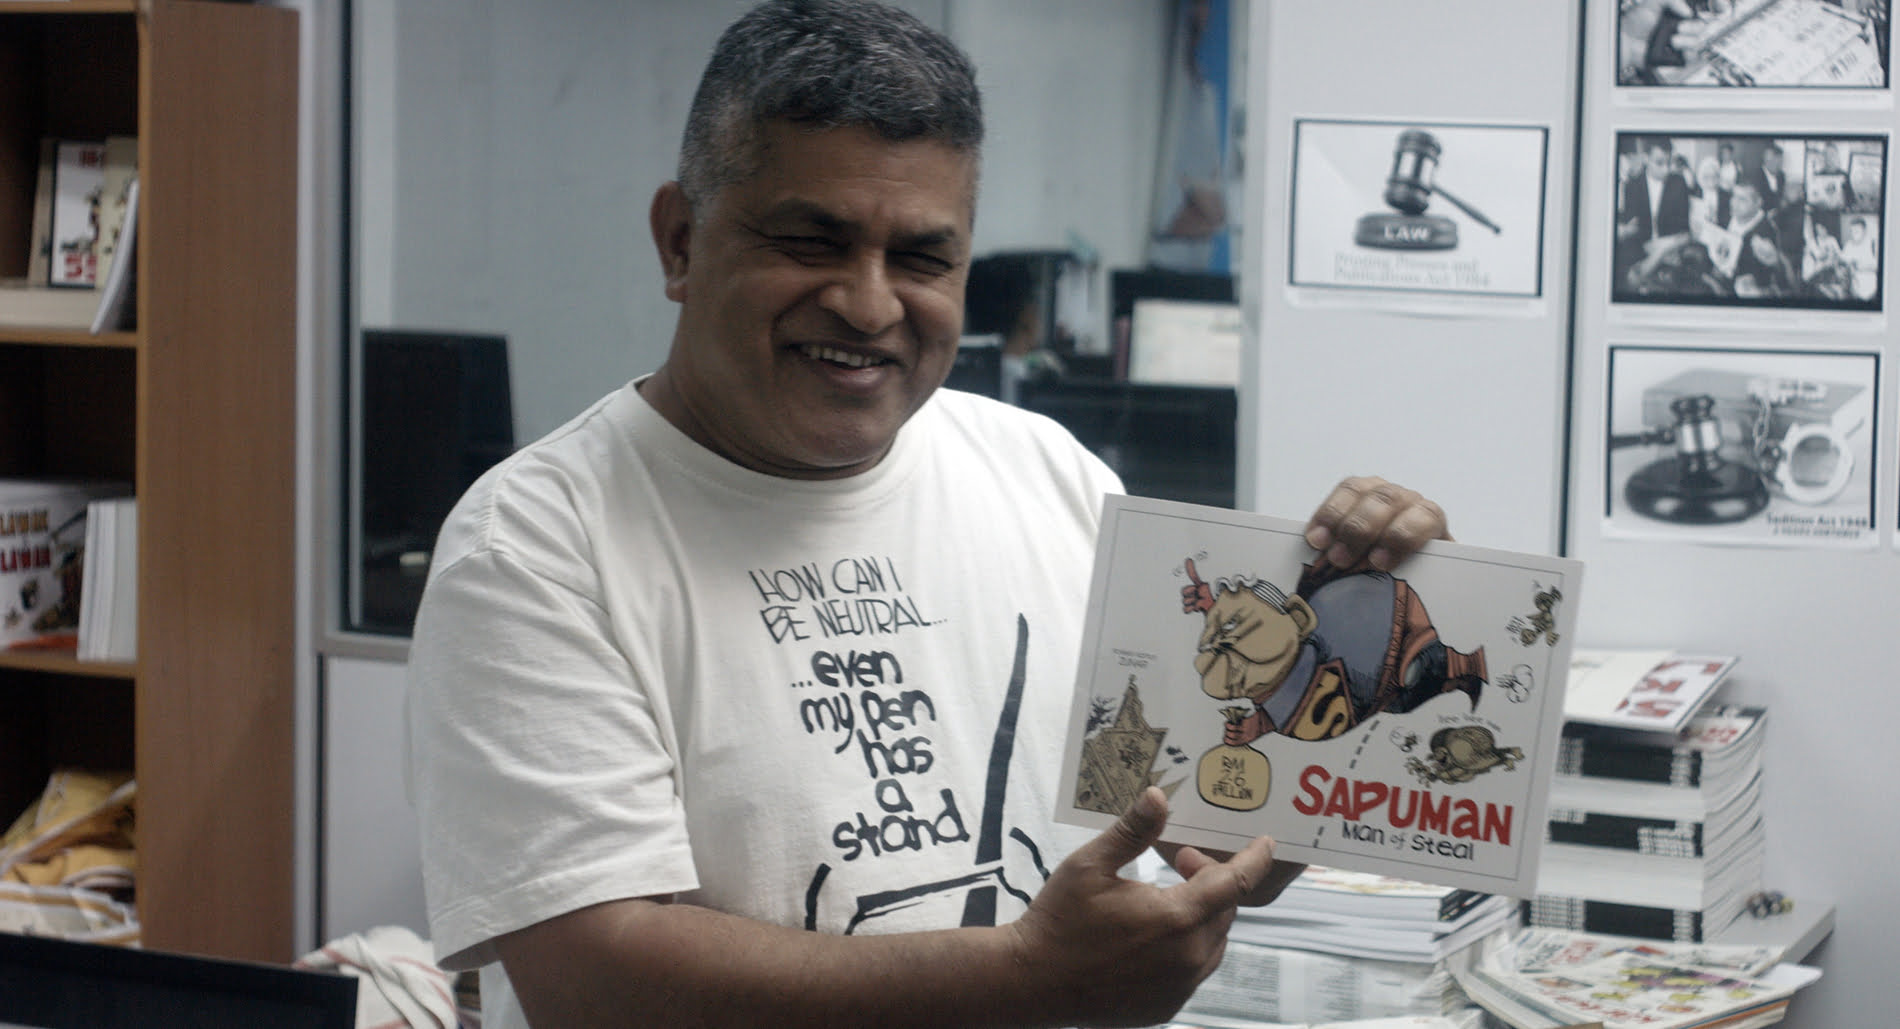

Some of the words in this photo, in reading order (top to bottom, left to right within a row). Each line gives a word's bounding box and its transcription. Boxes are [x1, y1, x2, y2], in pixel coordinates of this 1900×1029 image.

[1383, 223, 1431, 242] LAW
[748, 562, 826, 603] HOW
[832, 556, 886, 594] CAN
[886, 556, 903, 592] I
[760, 605, 811, 644] BE
[799, 692, 855, 754] my
[860, 689, 936, 740] pen
[856, 728, 935, 779] has
[875, 778, 914, 813] a
[832, 788, 970, 861] stand
[1342, 820, 1385, 846] Man
[1389, 831, 1406, 850] of
[1411, 833, 1475, 861] Steal
